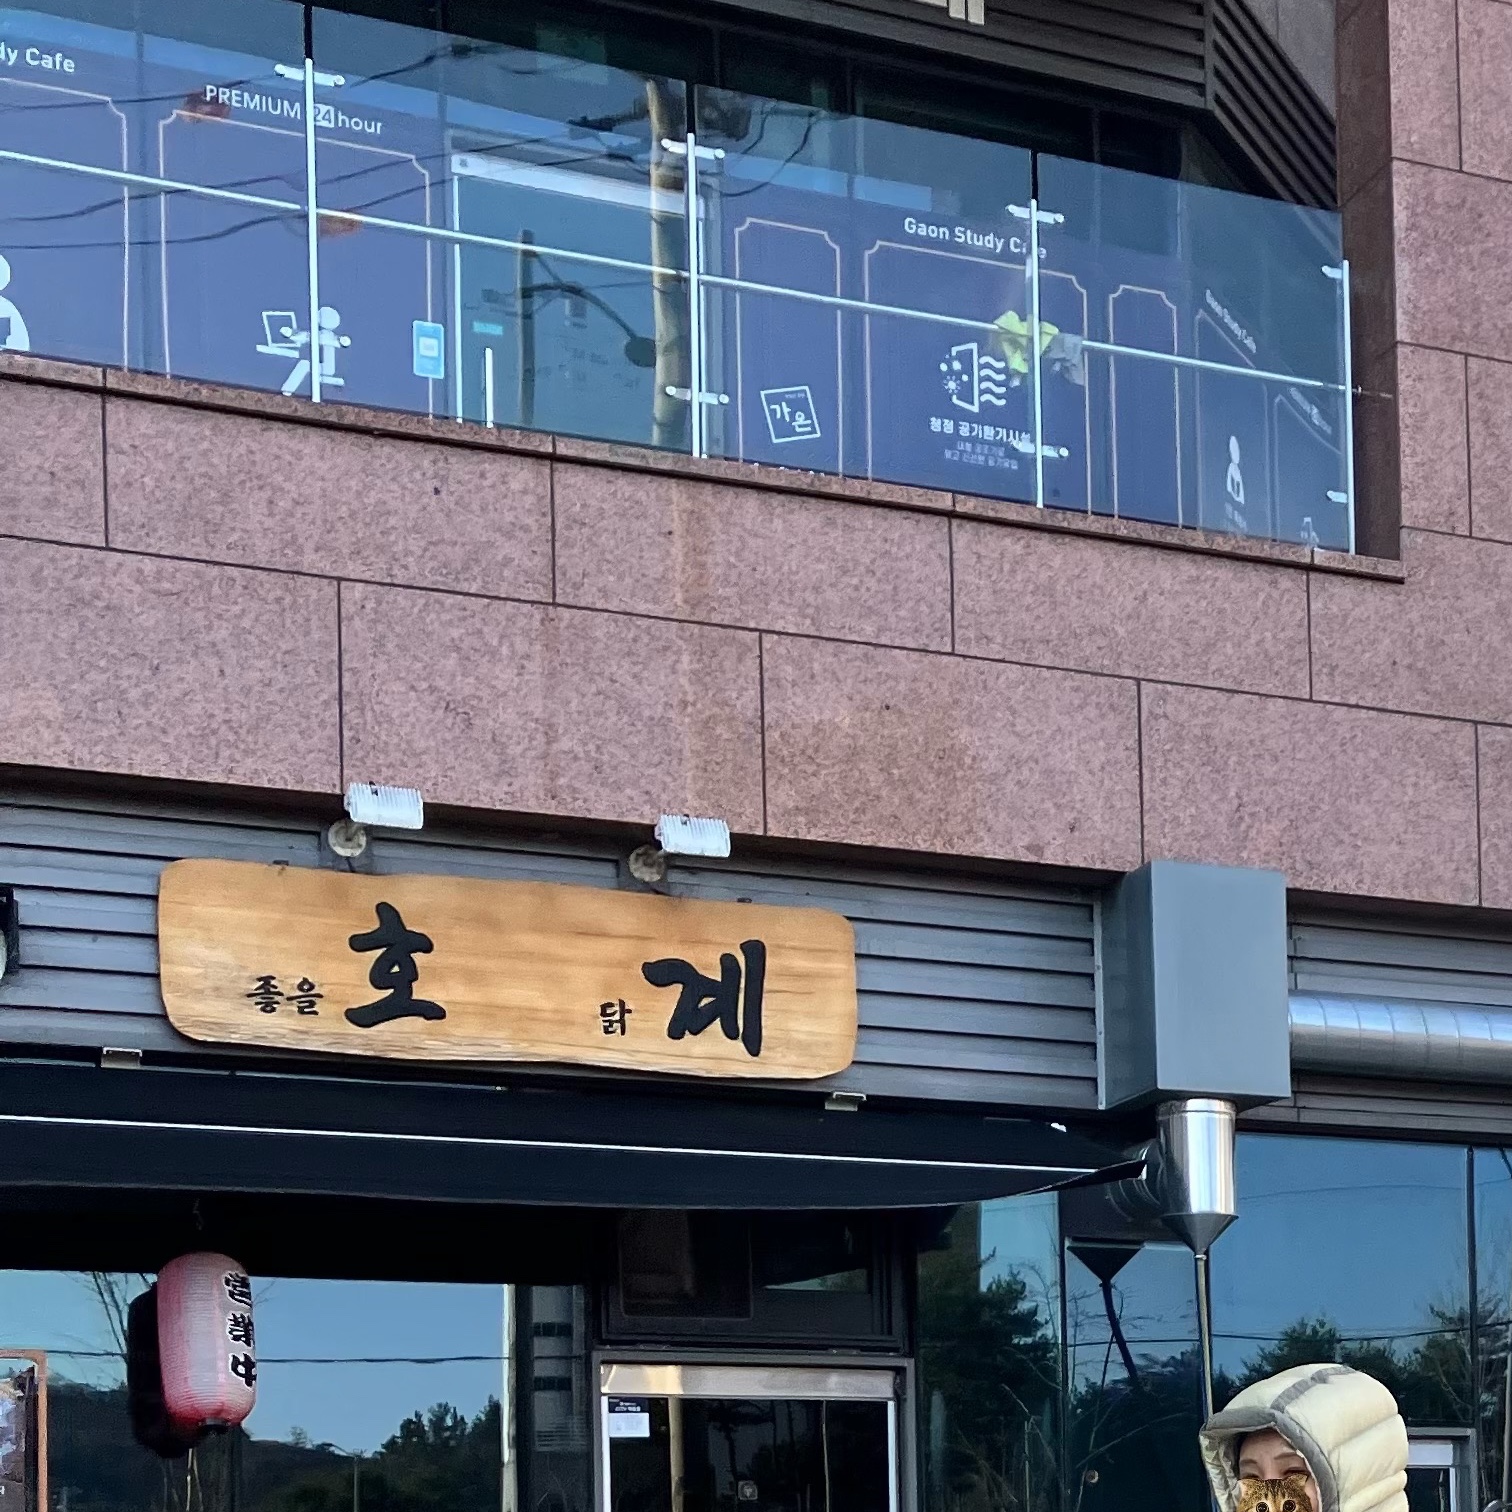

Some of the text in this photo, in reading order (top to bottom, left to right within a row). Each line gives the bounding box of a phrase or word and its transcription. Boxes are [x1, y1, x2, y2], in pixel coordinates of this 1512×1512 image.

[25, 47, 76, 73] Cafe
[205, 84, 301, 120] PREMIUM
[904, 217, 949, 240] Gaon
[954, 226, 1004, 253] Study
[769, 401, 812, 433] 가온
[246, 901, 767, 1057] 좋을 호 닭 계
